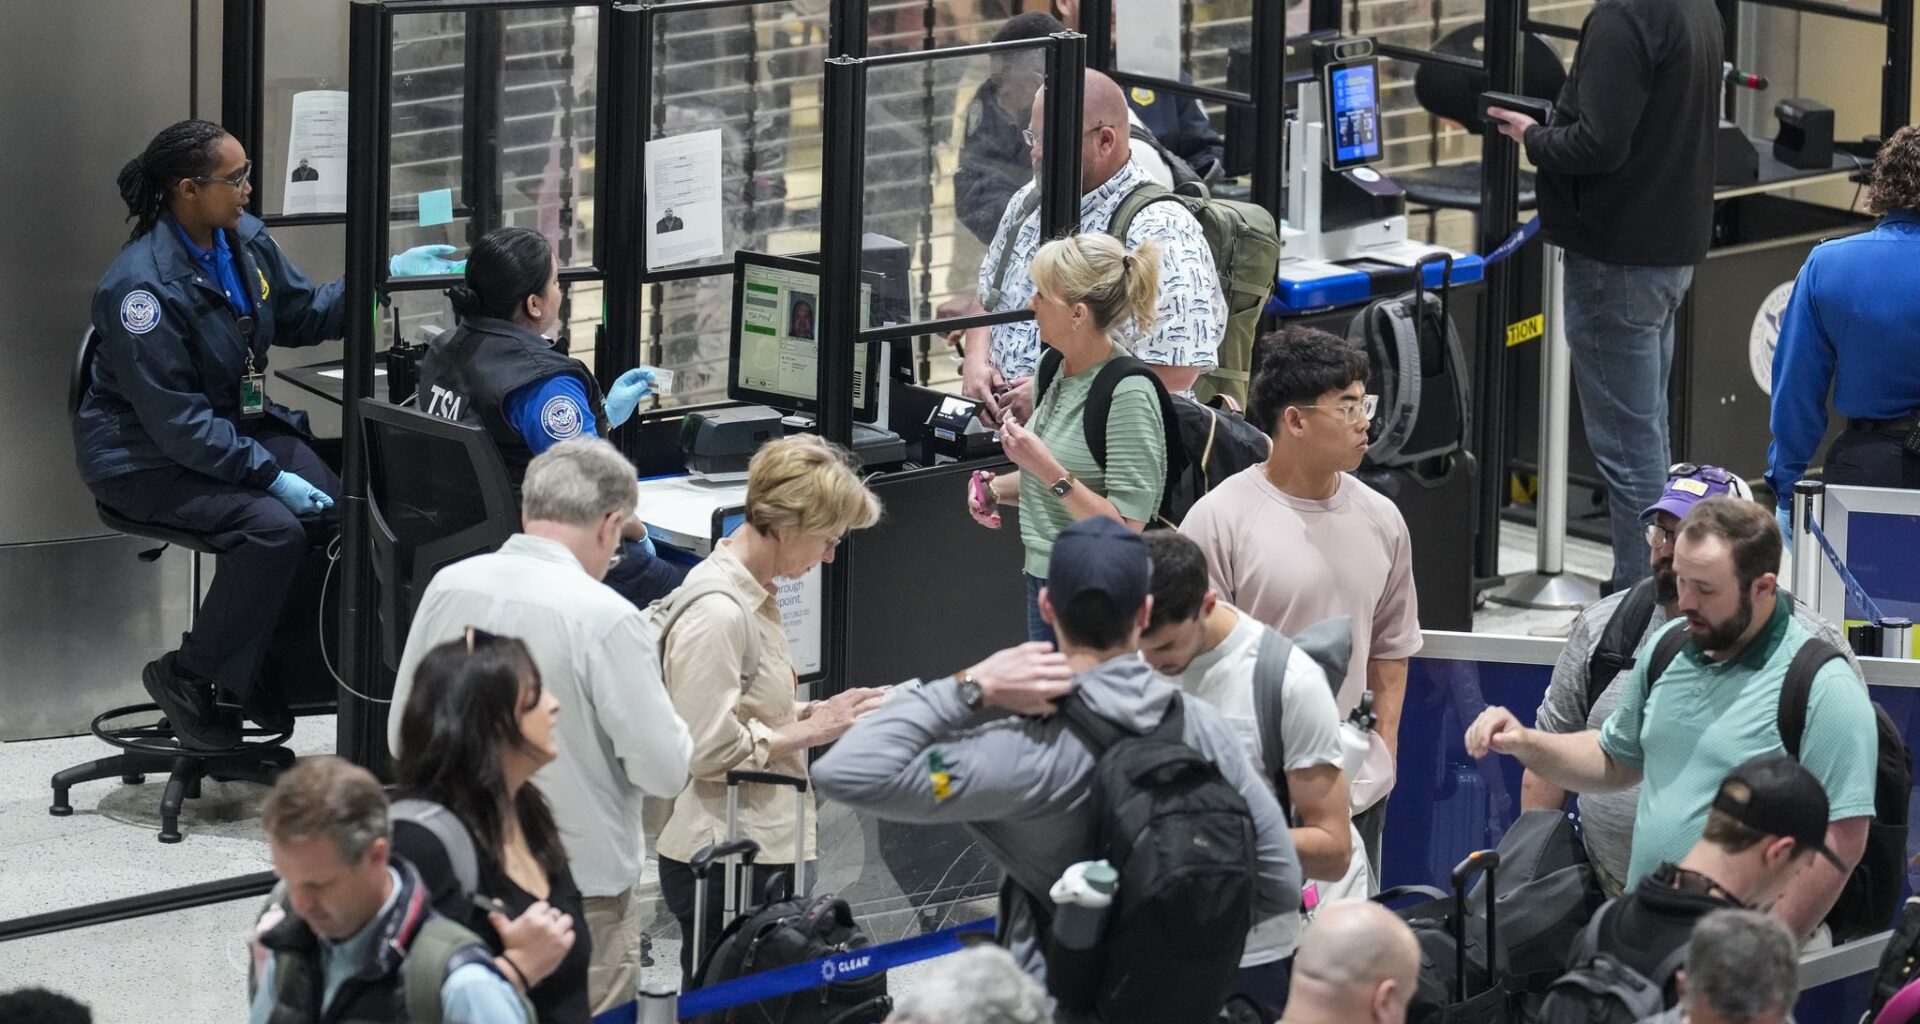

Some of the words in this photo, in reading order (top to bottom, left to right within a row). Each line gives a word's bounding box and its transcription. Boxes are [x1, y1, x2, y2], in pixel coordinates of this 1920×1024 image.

[1508, 318, 1538, 343] TION
[427, 384, 462, 421] TSA
[838, 956, 871, 973] CLEAR
